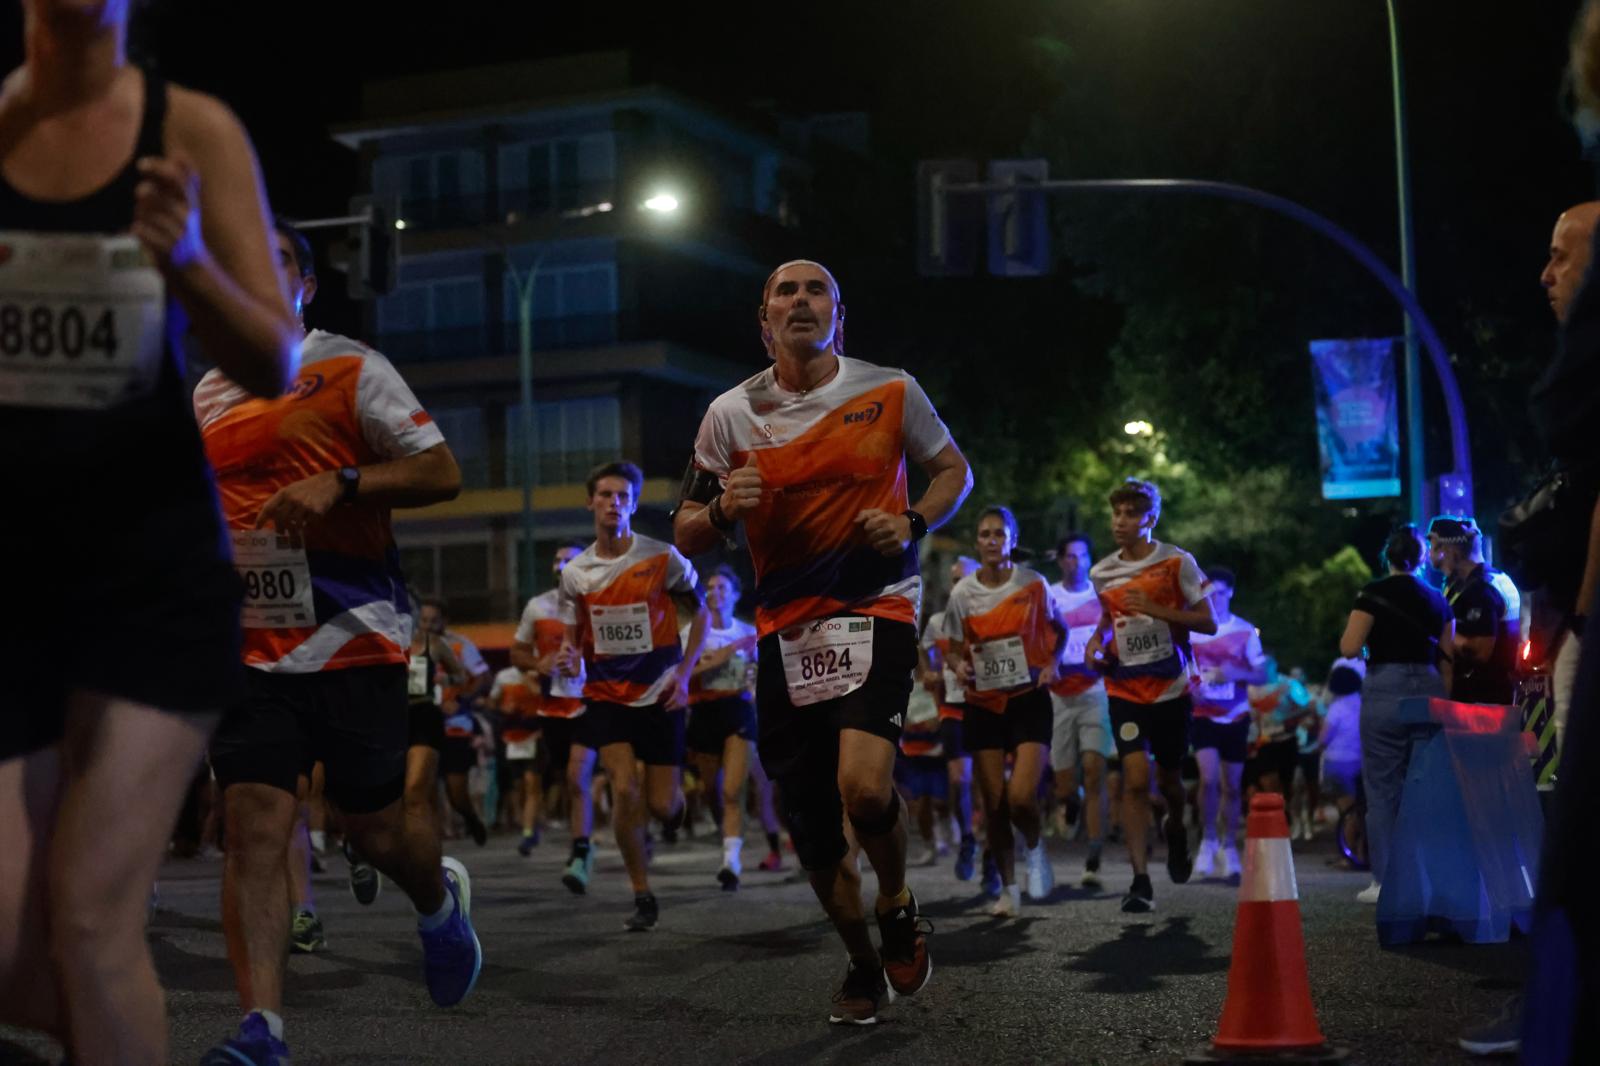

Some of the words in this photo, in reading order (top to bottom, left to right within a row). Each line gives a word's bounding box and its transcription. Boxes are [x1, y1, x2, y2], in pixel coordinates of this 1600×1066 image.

[1, 305, 116, 358] 8804
[246, 569, 295, 599] 980
[599, 624, 643, 641] 18625
[1127, 634, 1159, 652] 5081
[801, 648, 852, 680] 8624
[983, 658, 1016, 676] 5079
